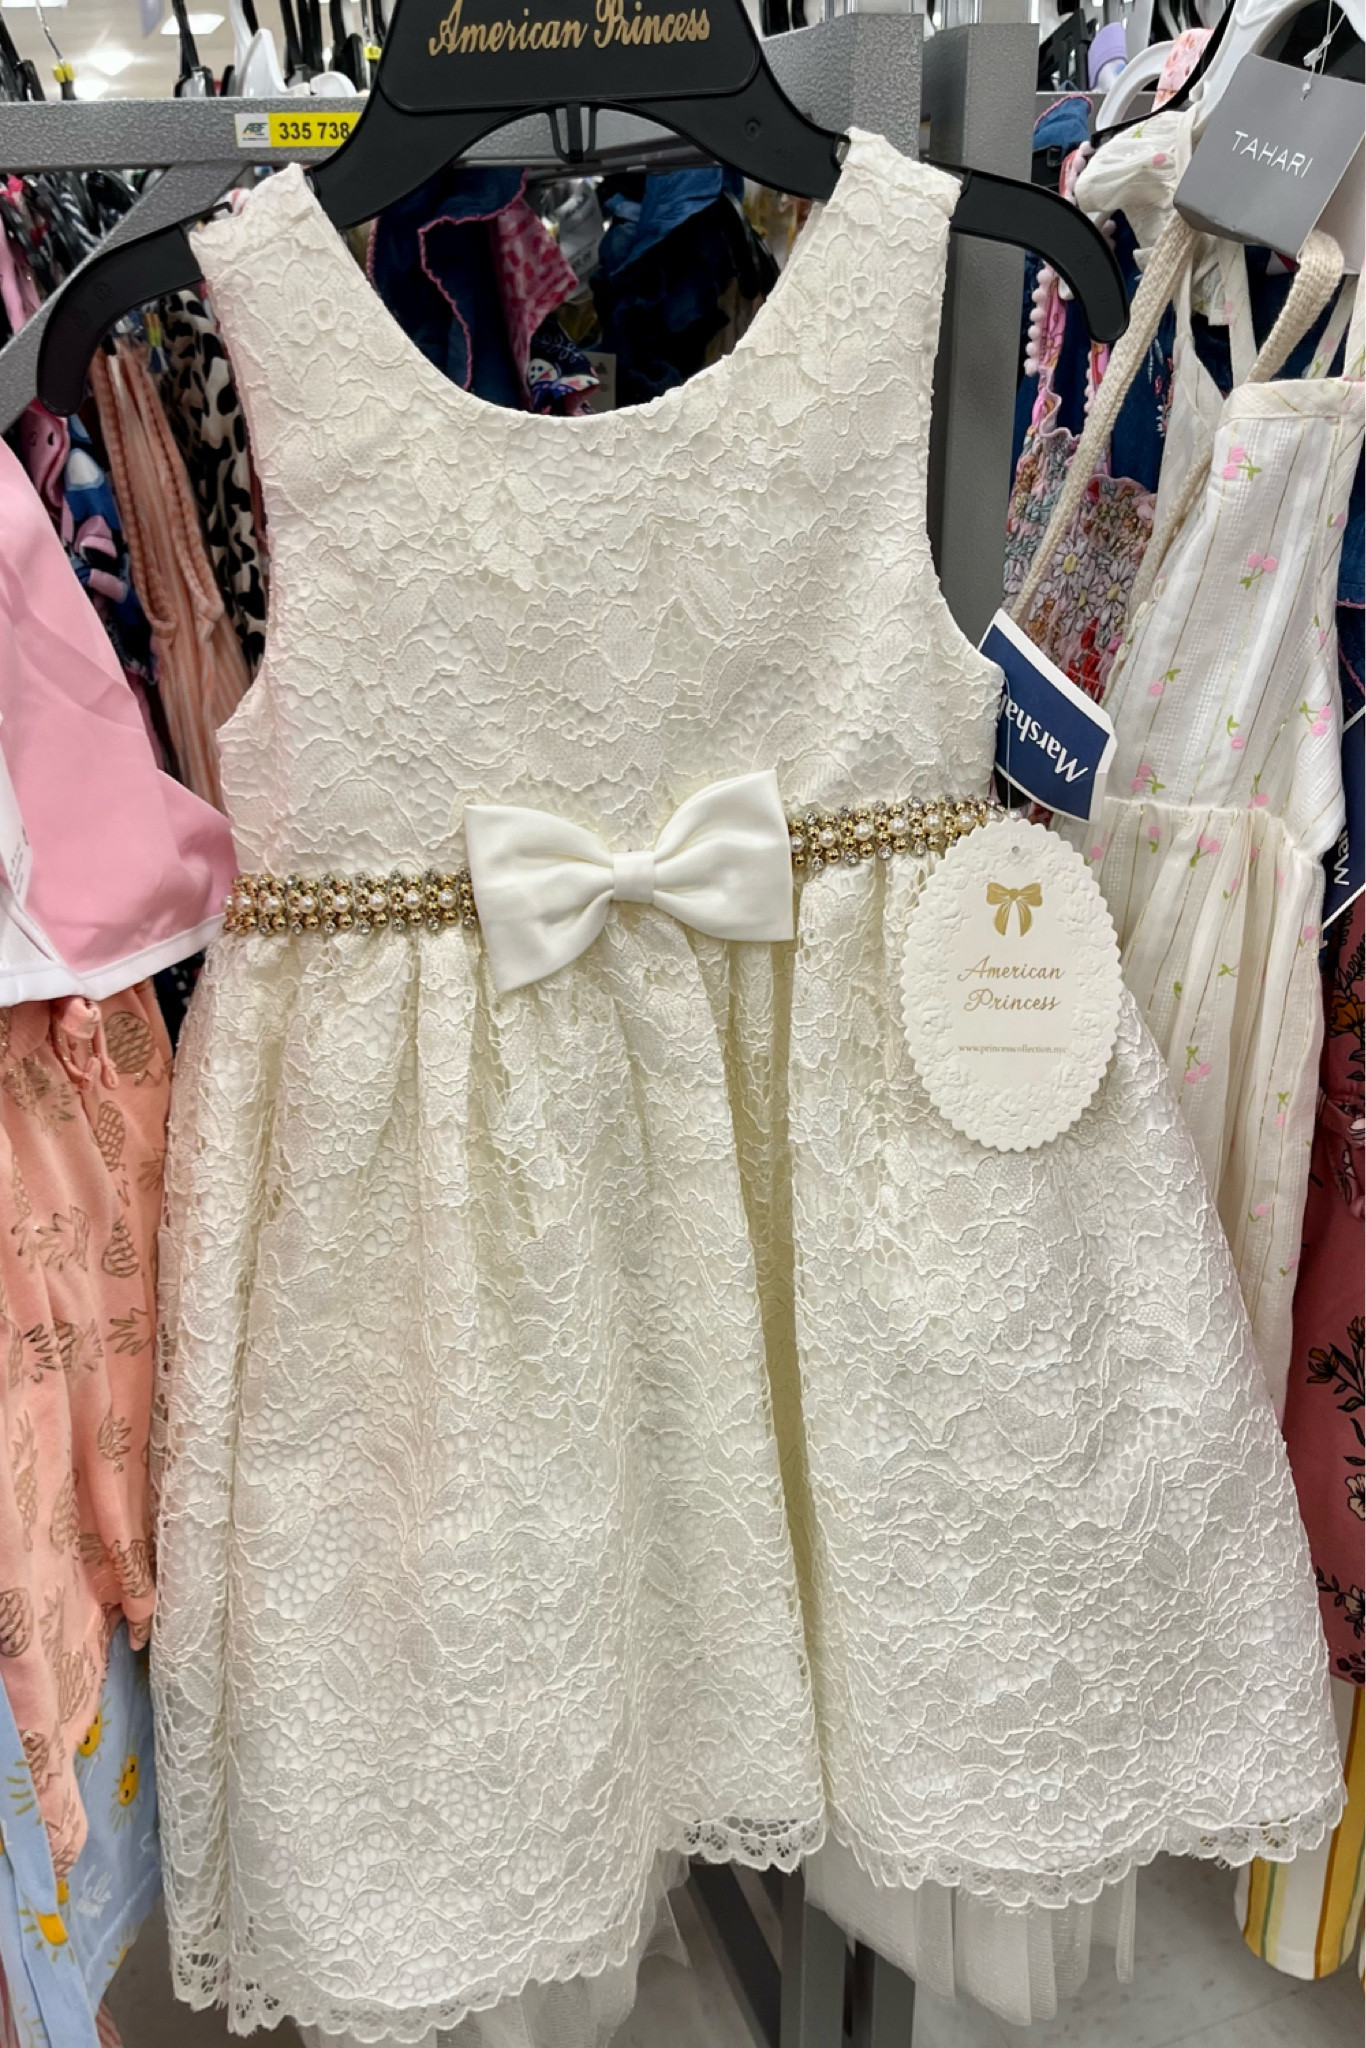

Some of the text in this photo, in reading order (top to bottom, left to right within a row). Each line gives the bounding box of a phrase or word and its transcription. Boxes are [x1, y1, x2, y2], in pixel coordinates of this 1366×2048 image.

[429, 0, 710, 56] American Princess
[279, 122, 350, 140] 335 738
[1232, 130, 1314, 178] TAHARI
[957, 954, 1065, 982] American
[963, 987, 1061, 1012] Princess
